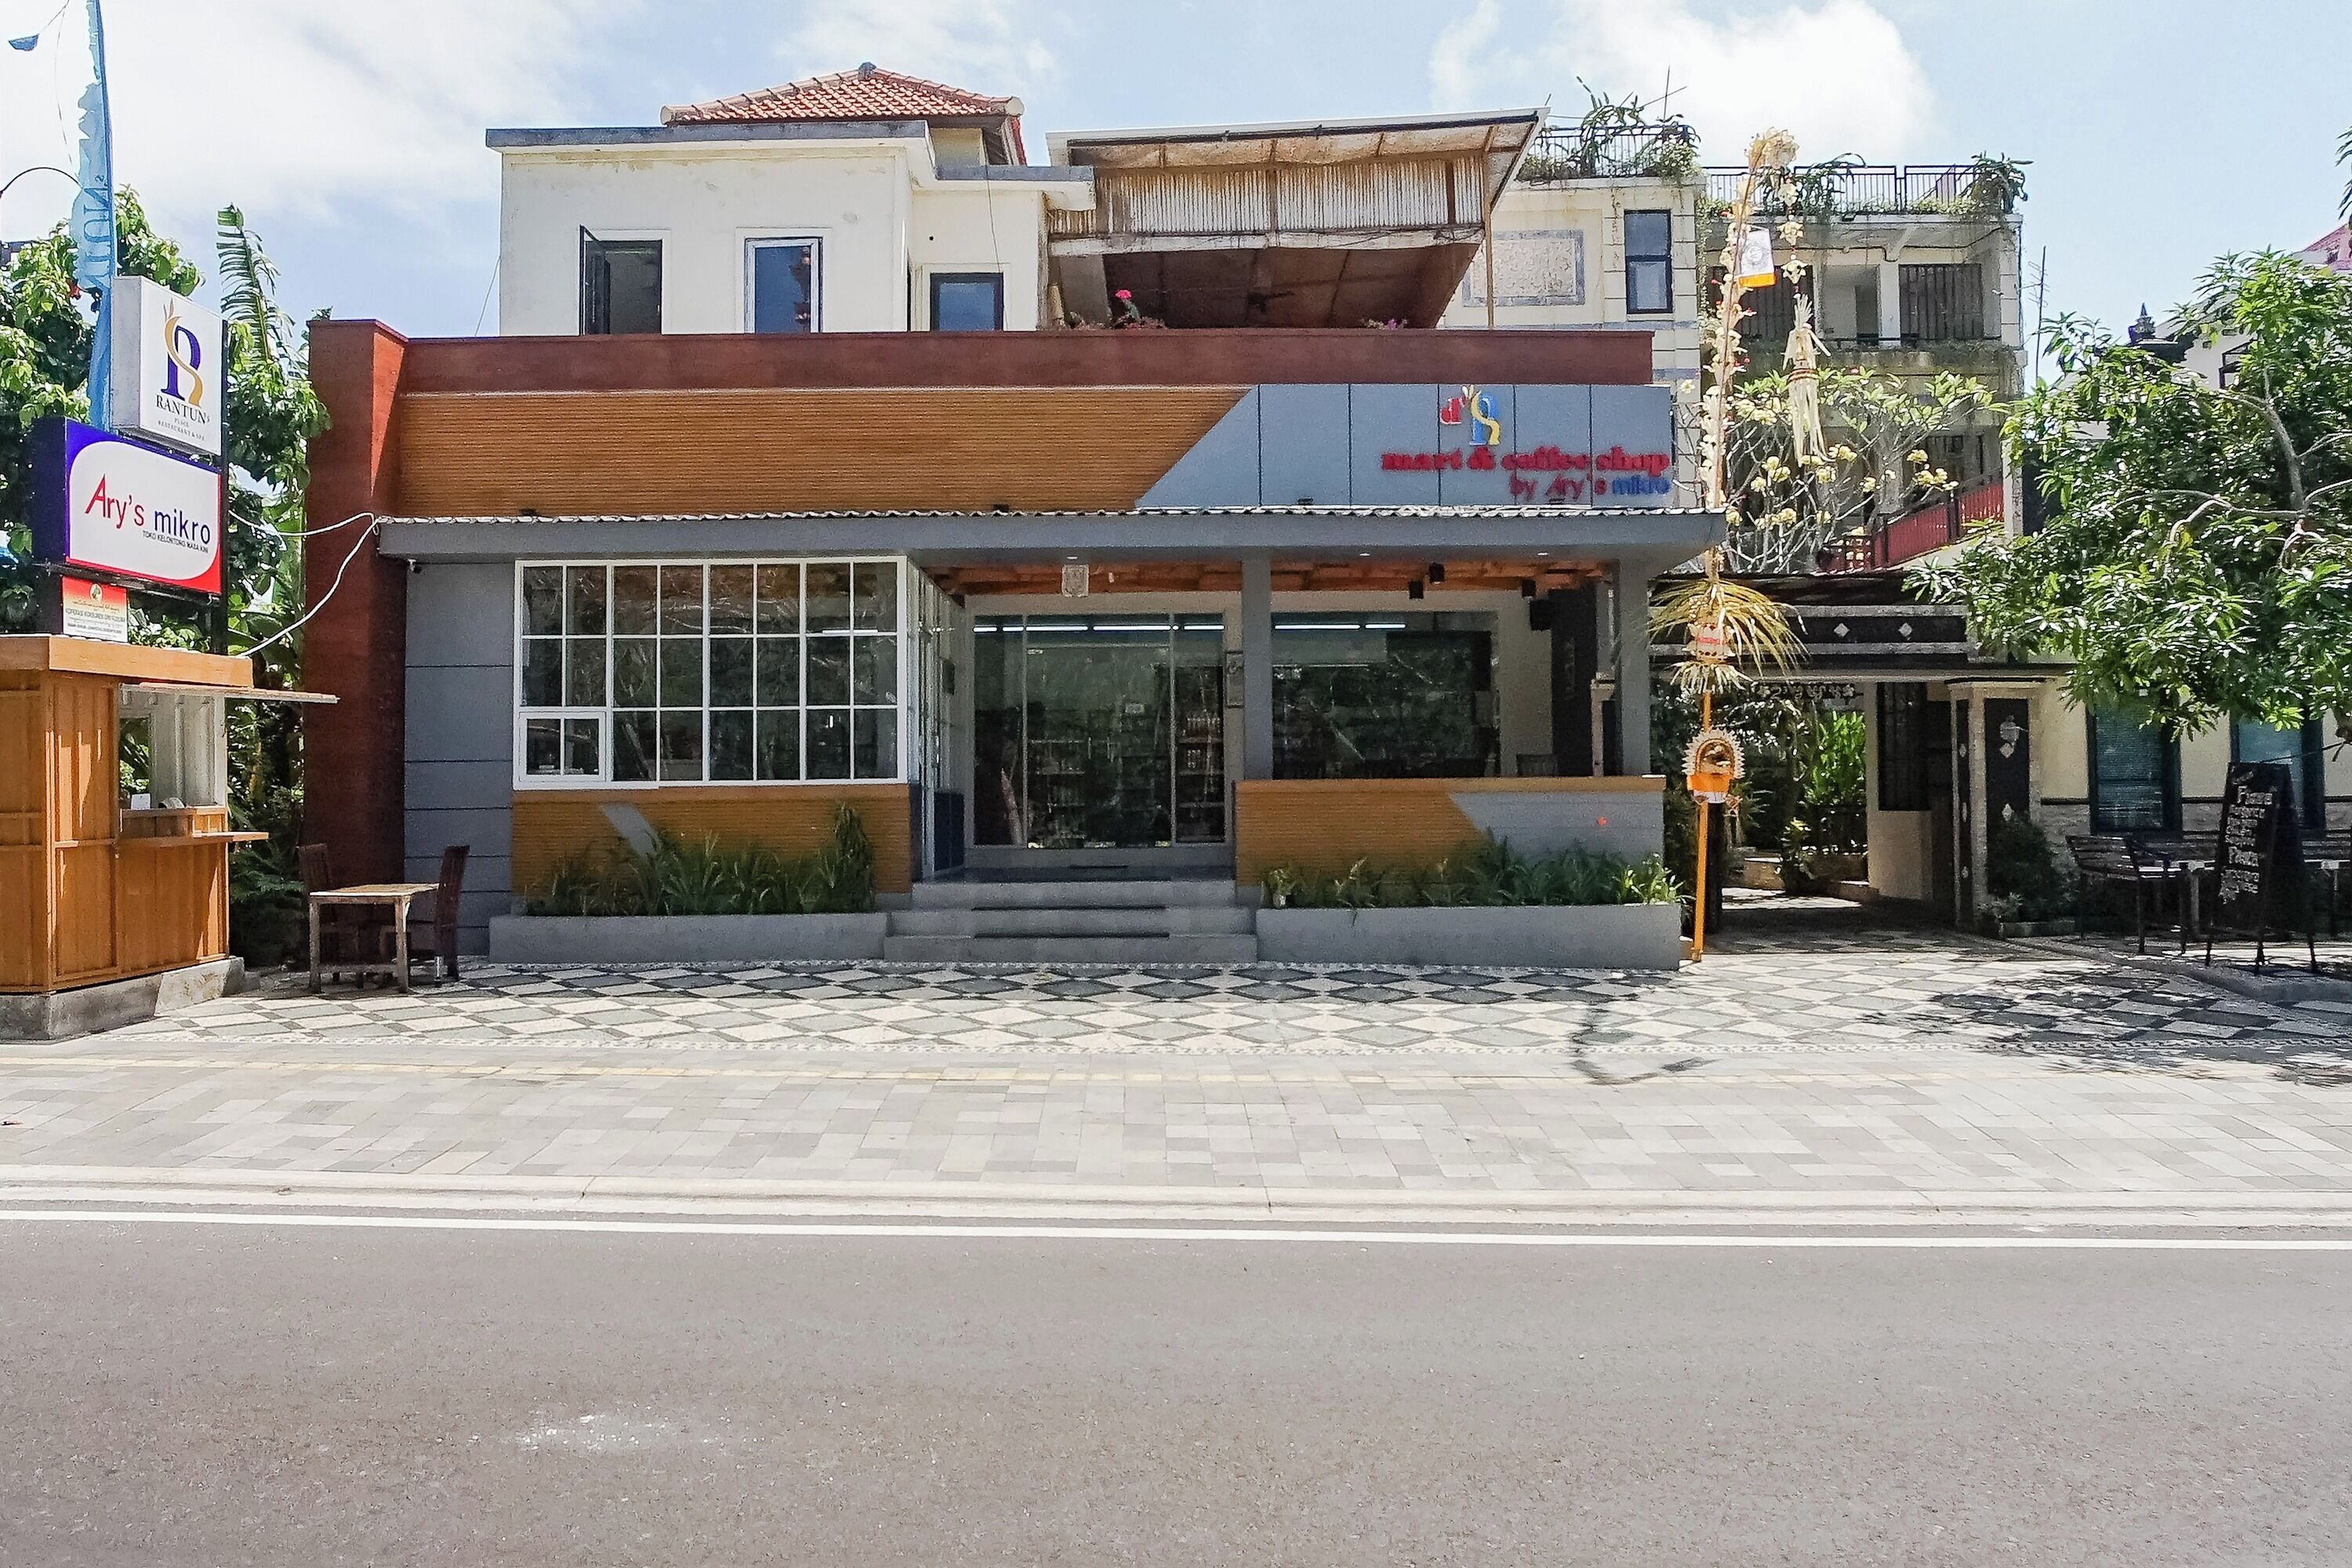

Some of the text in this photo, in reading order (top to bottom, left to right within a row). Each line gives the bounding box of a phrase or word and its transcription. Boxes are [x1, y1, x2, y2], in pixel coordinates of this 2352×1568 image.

[1381, 445, 1670, 477] mart & coffee shop
[1509, 472, 1671, 501] by Ary's mikro
[85, 473, 211, 545] Ary's mikro
[142, 530, 157, 540] TOKO
[157, 535, 186, 547] KELONTONG
